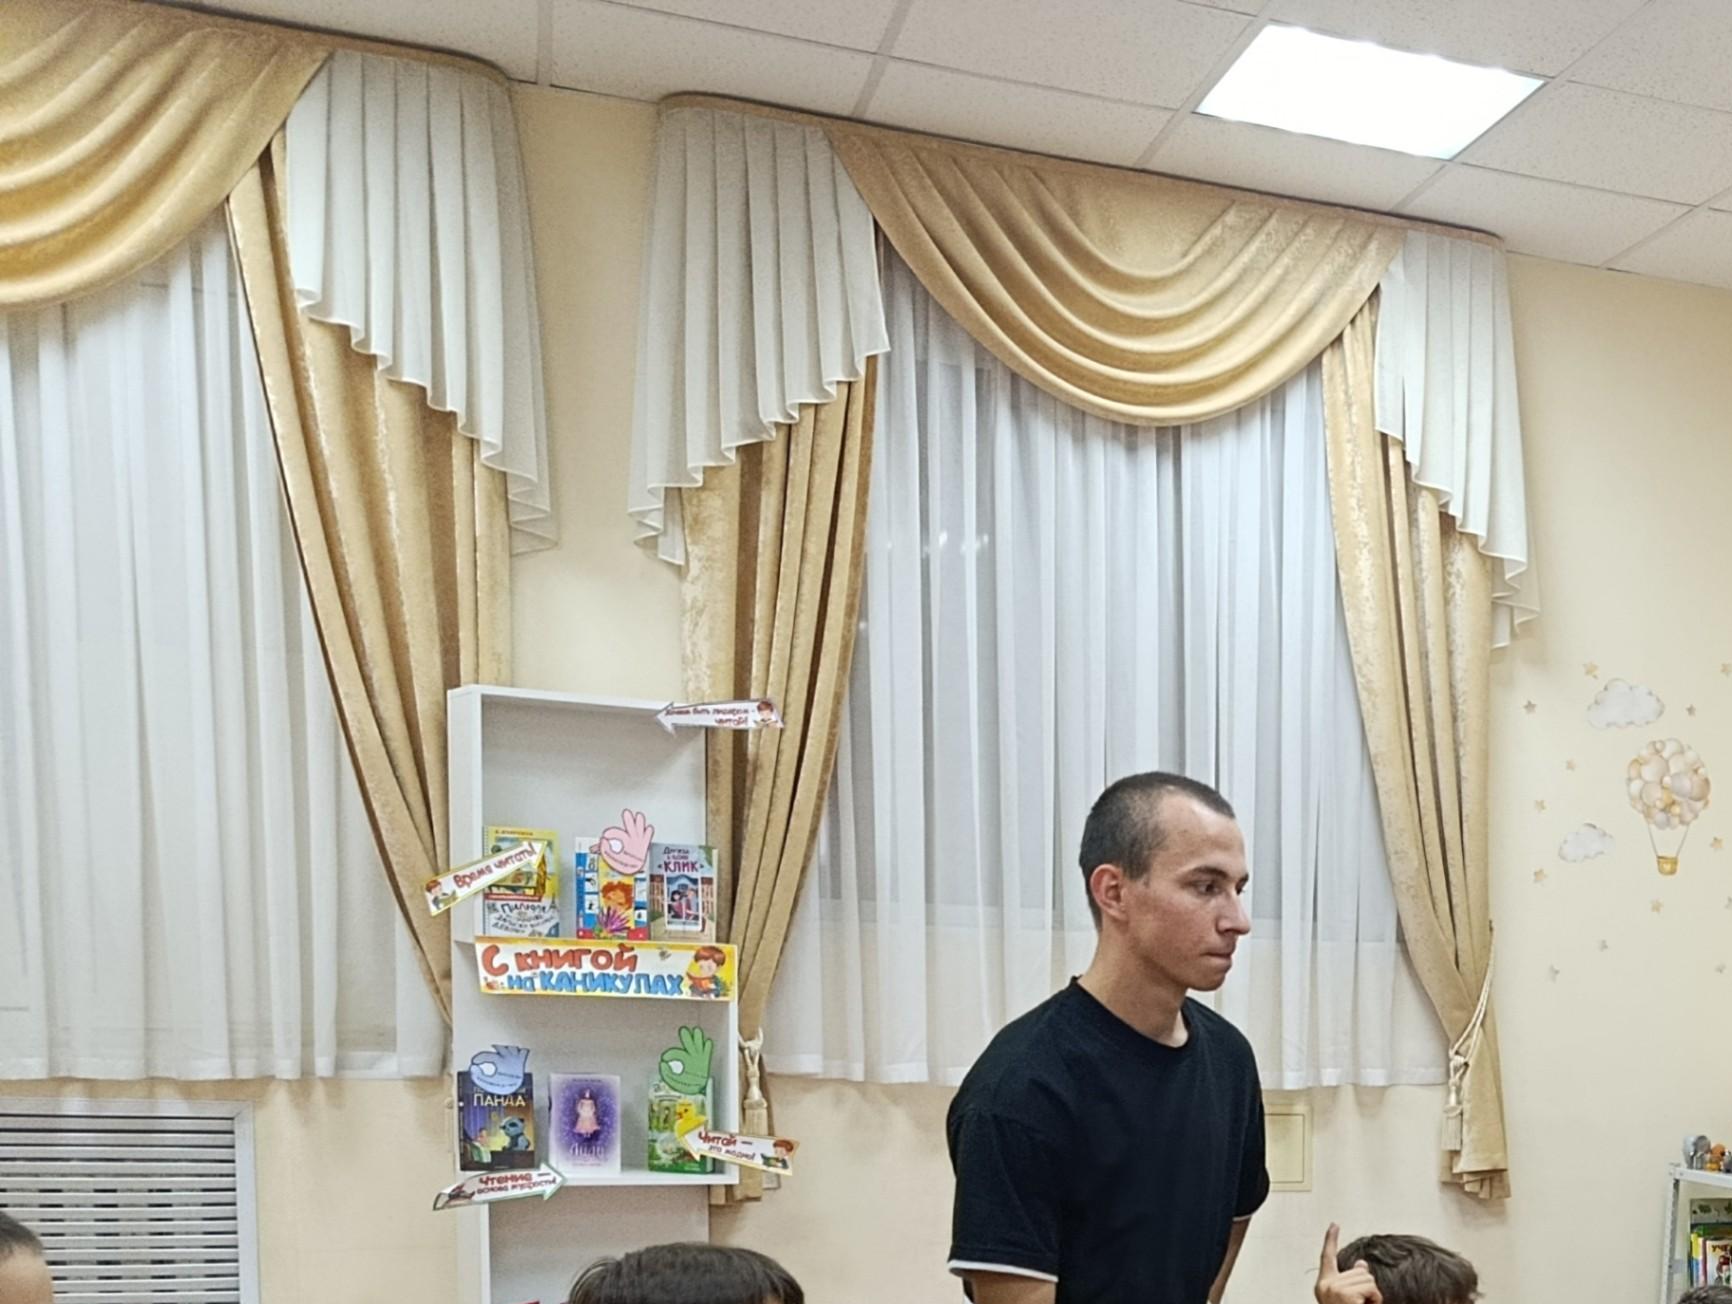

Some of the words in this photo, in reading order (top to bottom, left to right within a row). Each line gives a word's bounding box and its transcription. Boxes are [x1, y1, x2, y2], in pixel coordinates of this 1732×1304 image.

[453, 865, 494, 889] Время
[494, 841, 538, 869] читать!
[664, 861, 699, 873] КЛИК
[482, 944, 509, 977] С
[507, 974, 537, 991] на
[539, 971, 684, 996] КАНИКУЛАХ
[473, 1093, 526, 1107] ПАНДА
[698, 1131, 737, 1147] Читай
